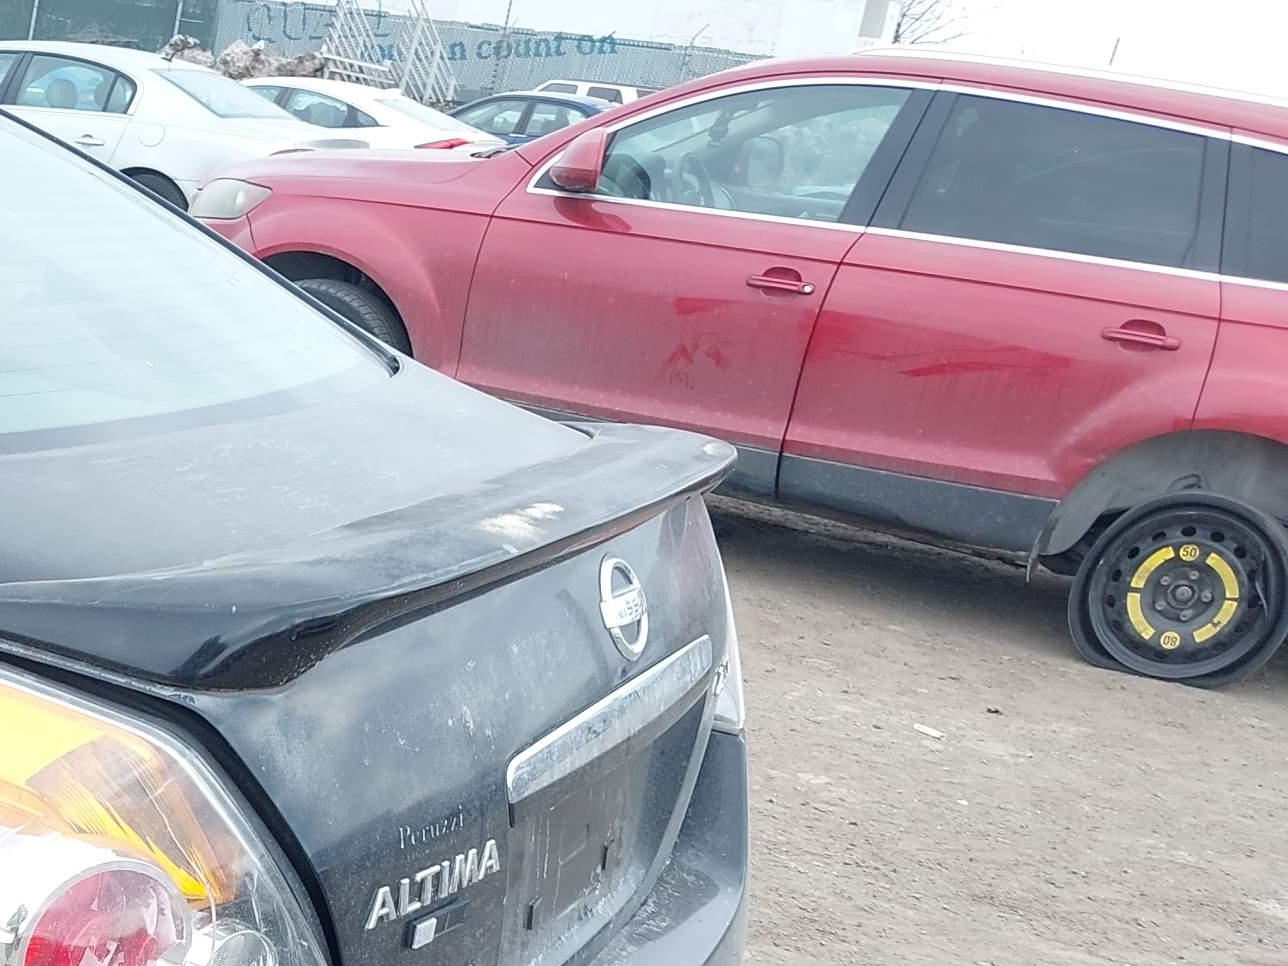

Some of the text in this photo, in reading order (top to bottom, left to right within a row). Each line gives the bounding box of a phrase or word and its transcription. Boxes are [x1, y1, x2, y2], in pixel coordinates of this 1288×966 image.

[477, 32, 565, 60] count
[576, 34, 618, 56] on
[1182, 546, 1198, 558] 50
[399, 804, 463, 849] Peruzzi
[365, 838, 500, 930] ALTIMA
